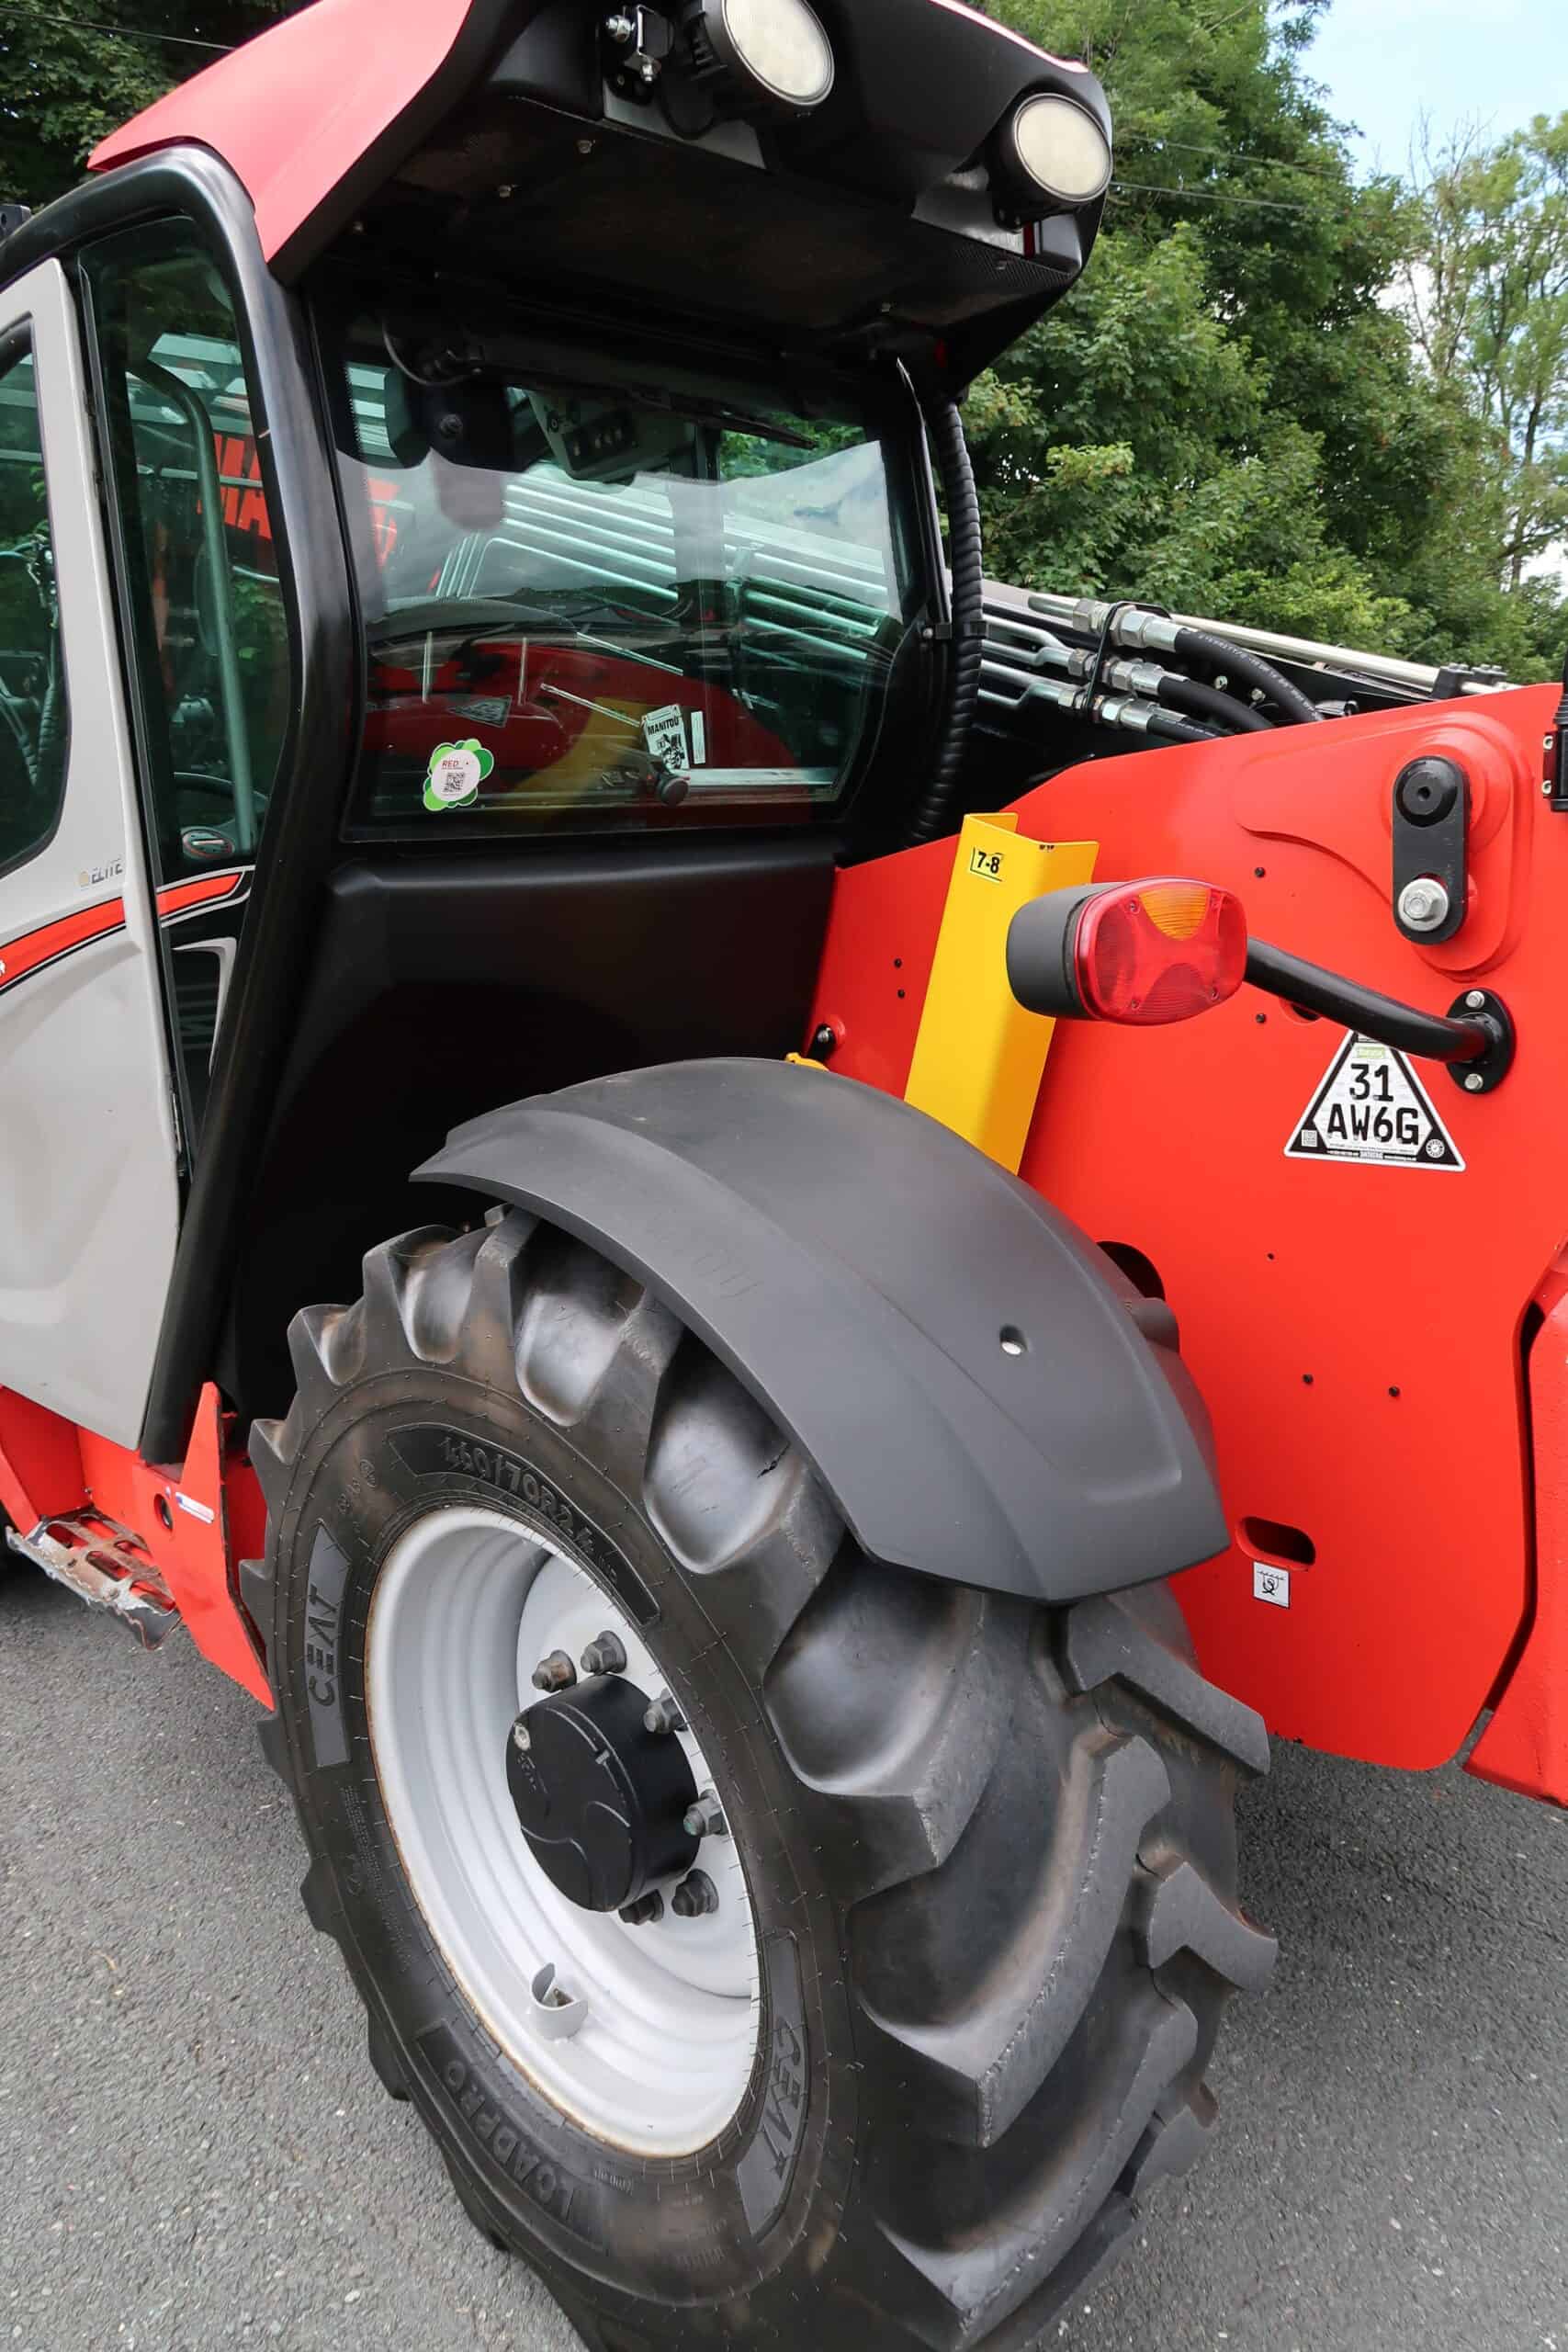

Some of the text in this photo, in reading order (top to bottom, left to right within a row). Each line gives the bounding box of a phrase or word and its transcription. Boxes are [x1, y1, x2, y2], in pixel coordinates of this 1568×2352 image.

[648, 717, 680, 735] MANITOU
[977, 851, 1000, 874] 7-8
[1349, 1063, 1393, 1102] 31
[1327, 1103, 1419, 1146] AW6G
[307, 1582, 338, 1707] CEAT
